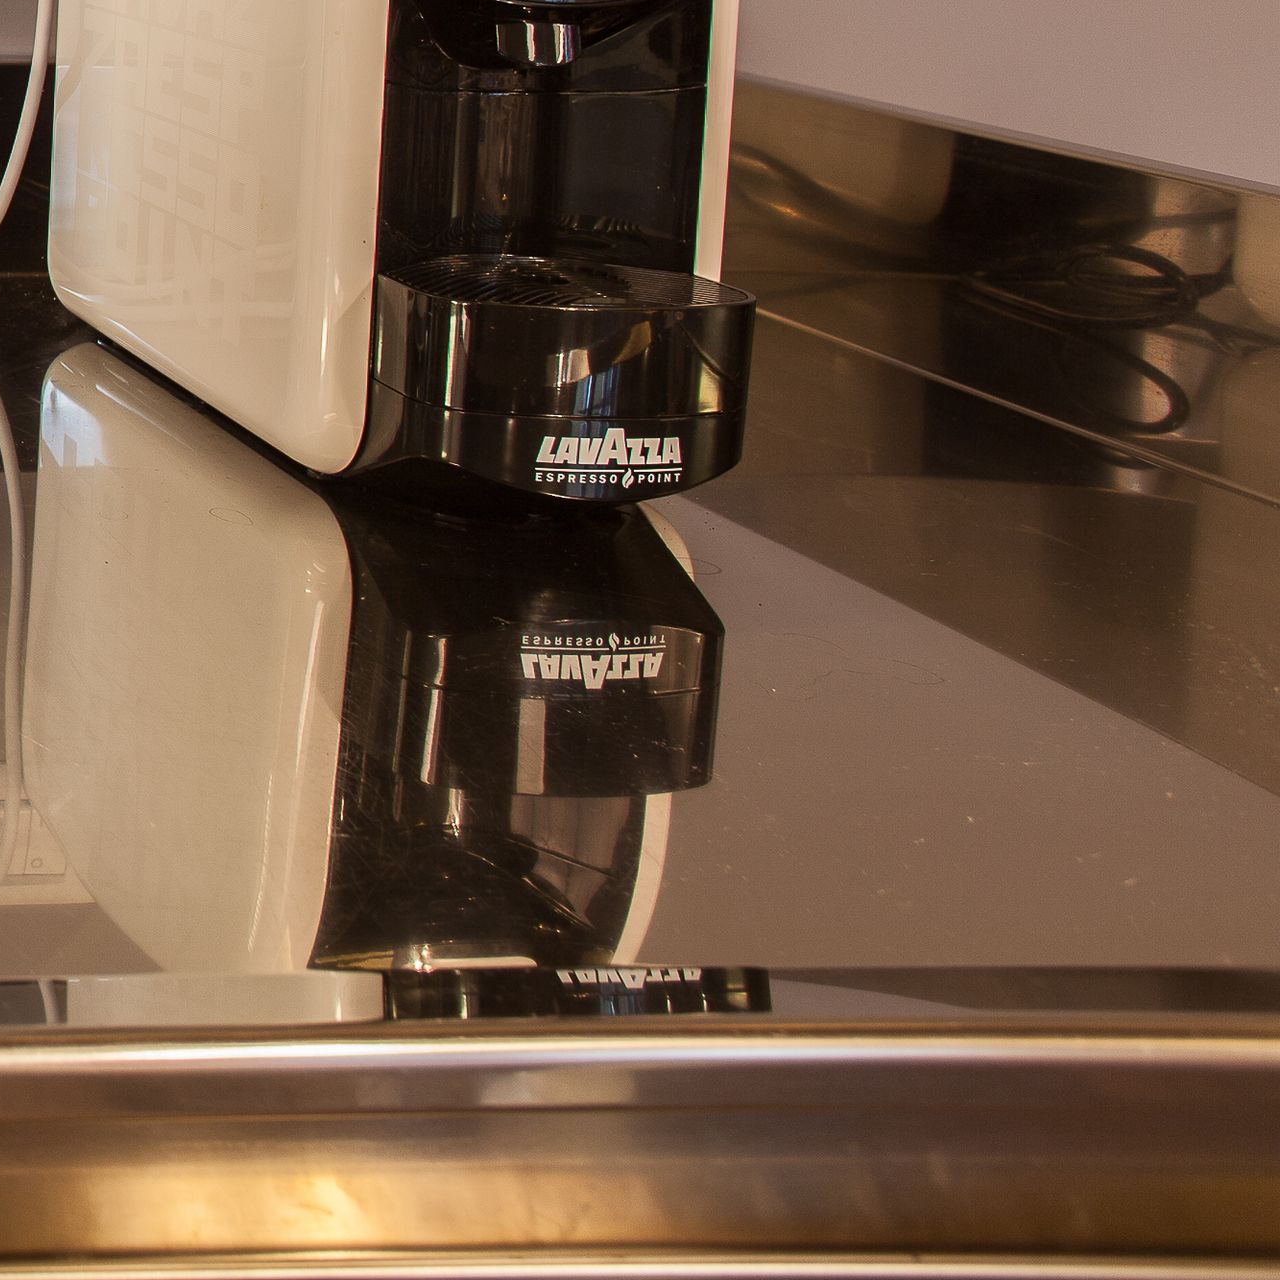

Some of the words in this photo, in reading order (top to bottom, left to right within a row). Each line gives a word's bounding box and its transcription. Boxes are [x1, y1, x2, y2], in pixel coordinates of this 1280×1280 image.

[536, 427, 682, 465] LAVAZZA
[535, 472, 618, 484] ESPRESSO
[637, 472, 682, 484] POINT
